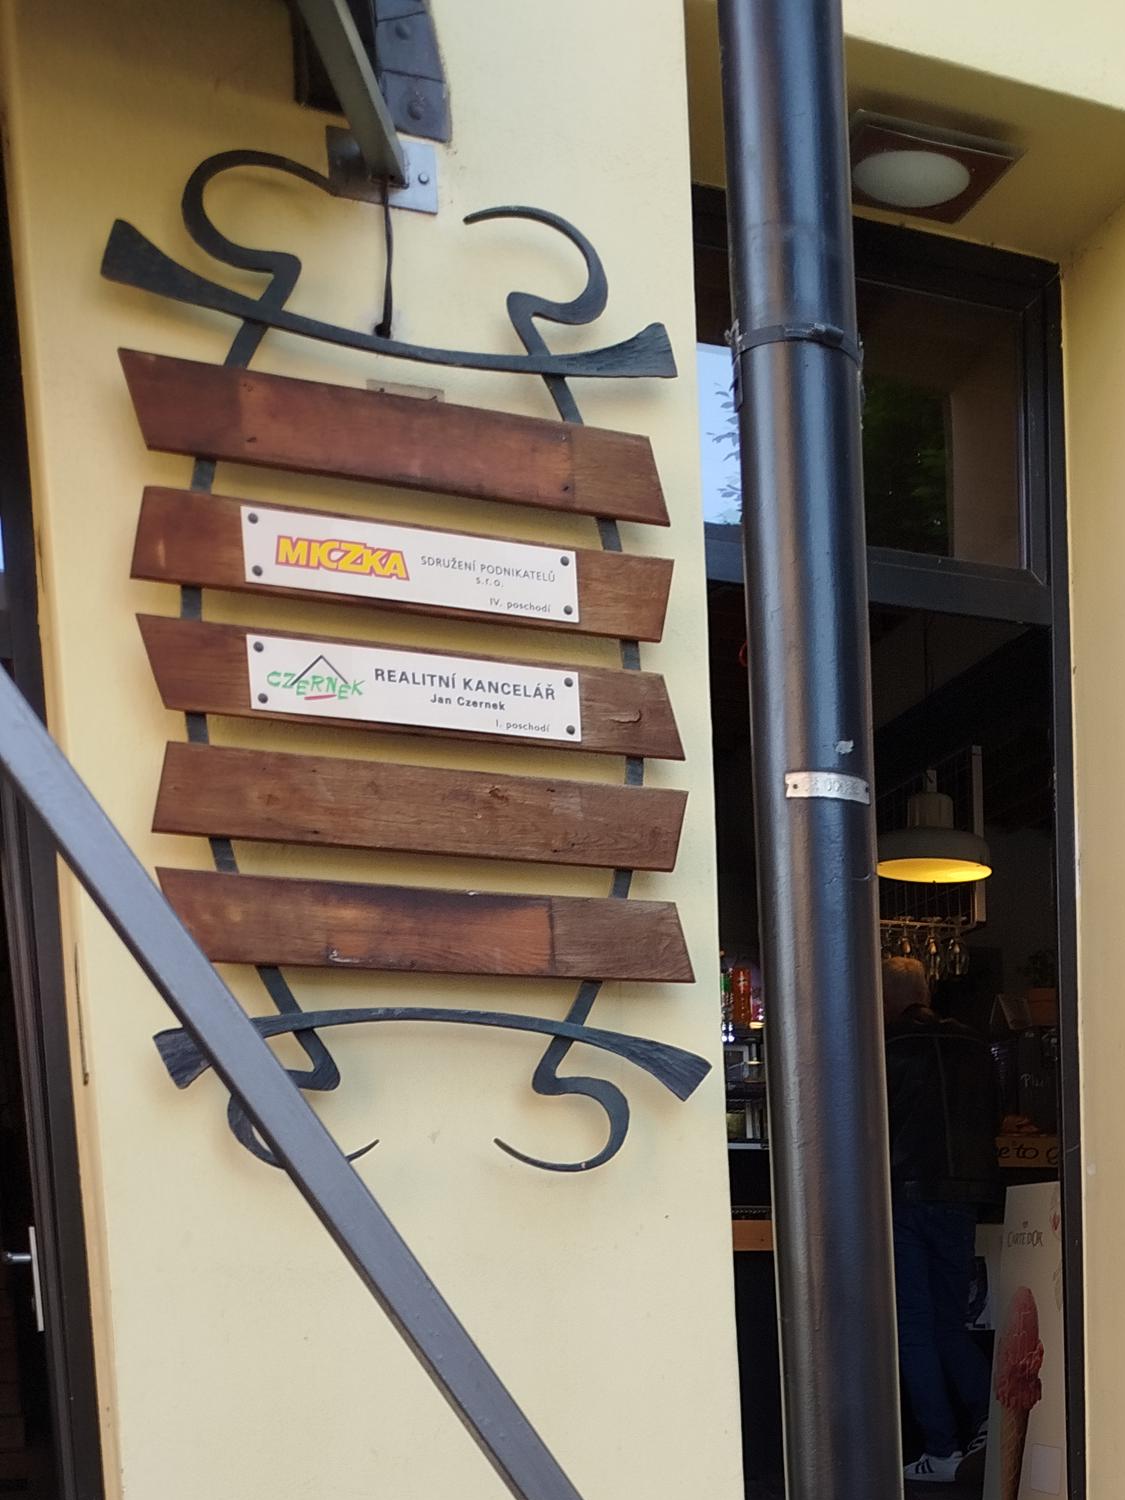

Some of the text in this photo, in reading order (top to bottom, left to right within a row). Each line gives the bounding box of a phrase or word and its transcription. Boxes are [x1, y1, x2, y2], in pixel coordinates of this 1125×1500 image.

[275, 535, 410, 581] MICZKA
[420, 555, 556, 583] SDRUŽENÍ PODNIKATELŮ
[475, 576, 505, 588] s.r.o.
[489, 597, 551, 613] IV. poschodí
[266, 670, 366, 700] CZERNEK
[374, 668, 556, 700] REALITNÍ KANCELÁŘ
[430, 693, 506, 711] Jan Czernek
[506, 720, 550, 733] poschodí
